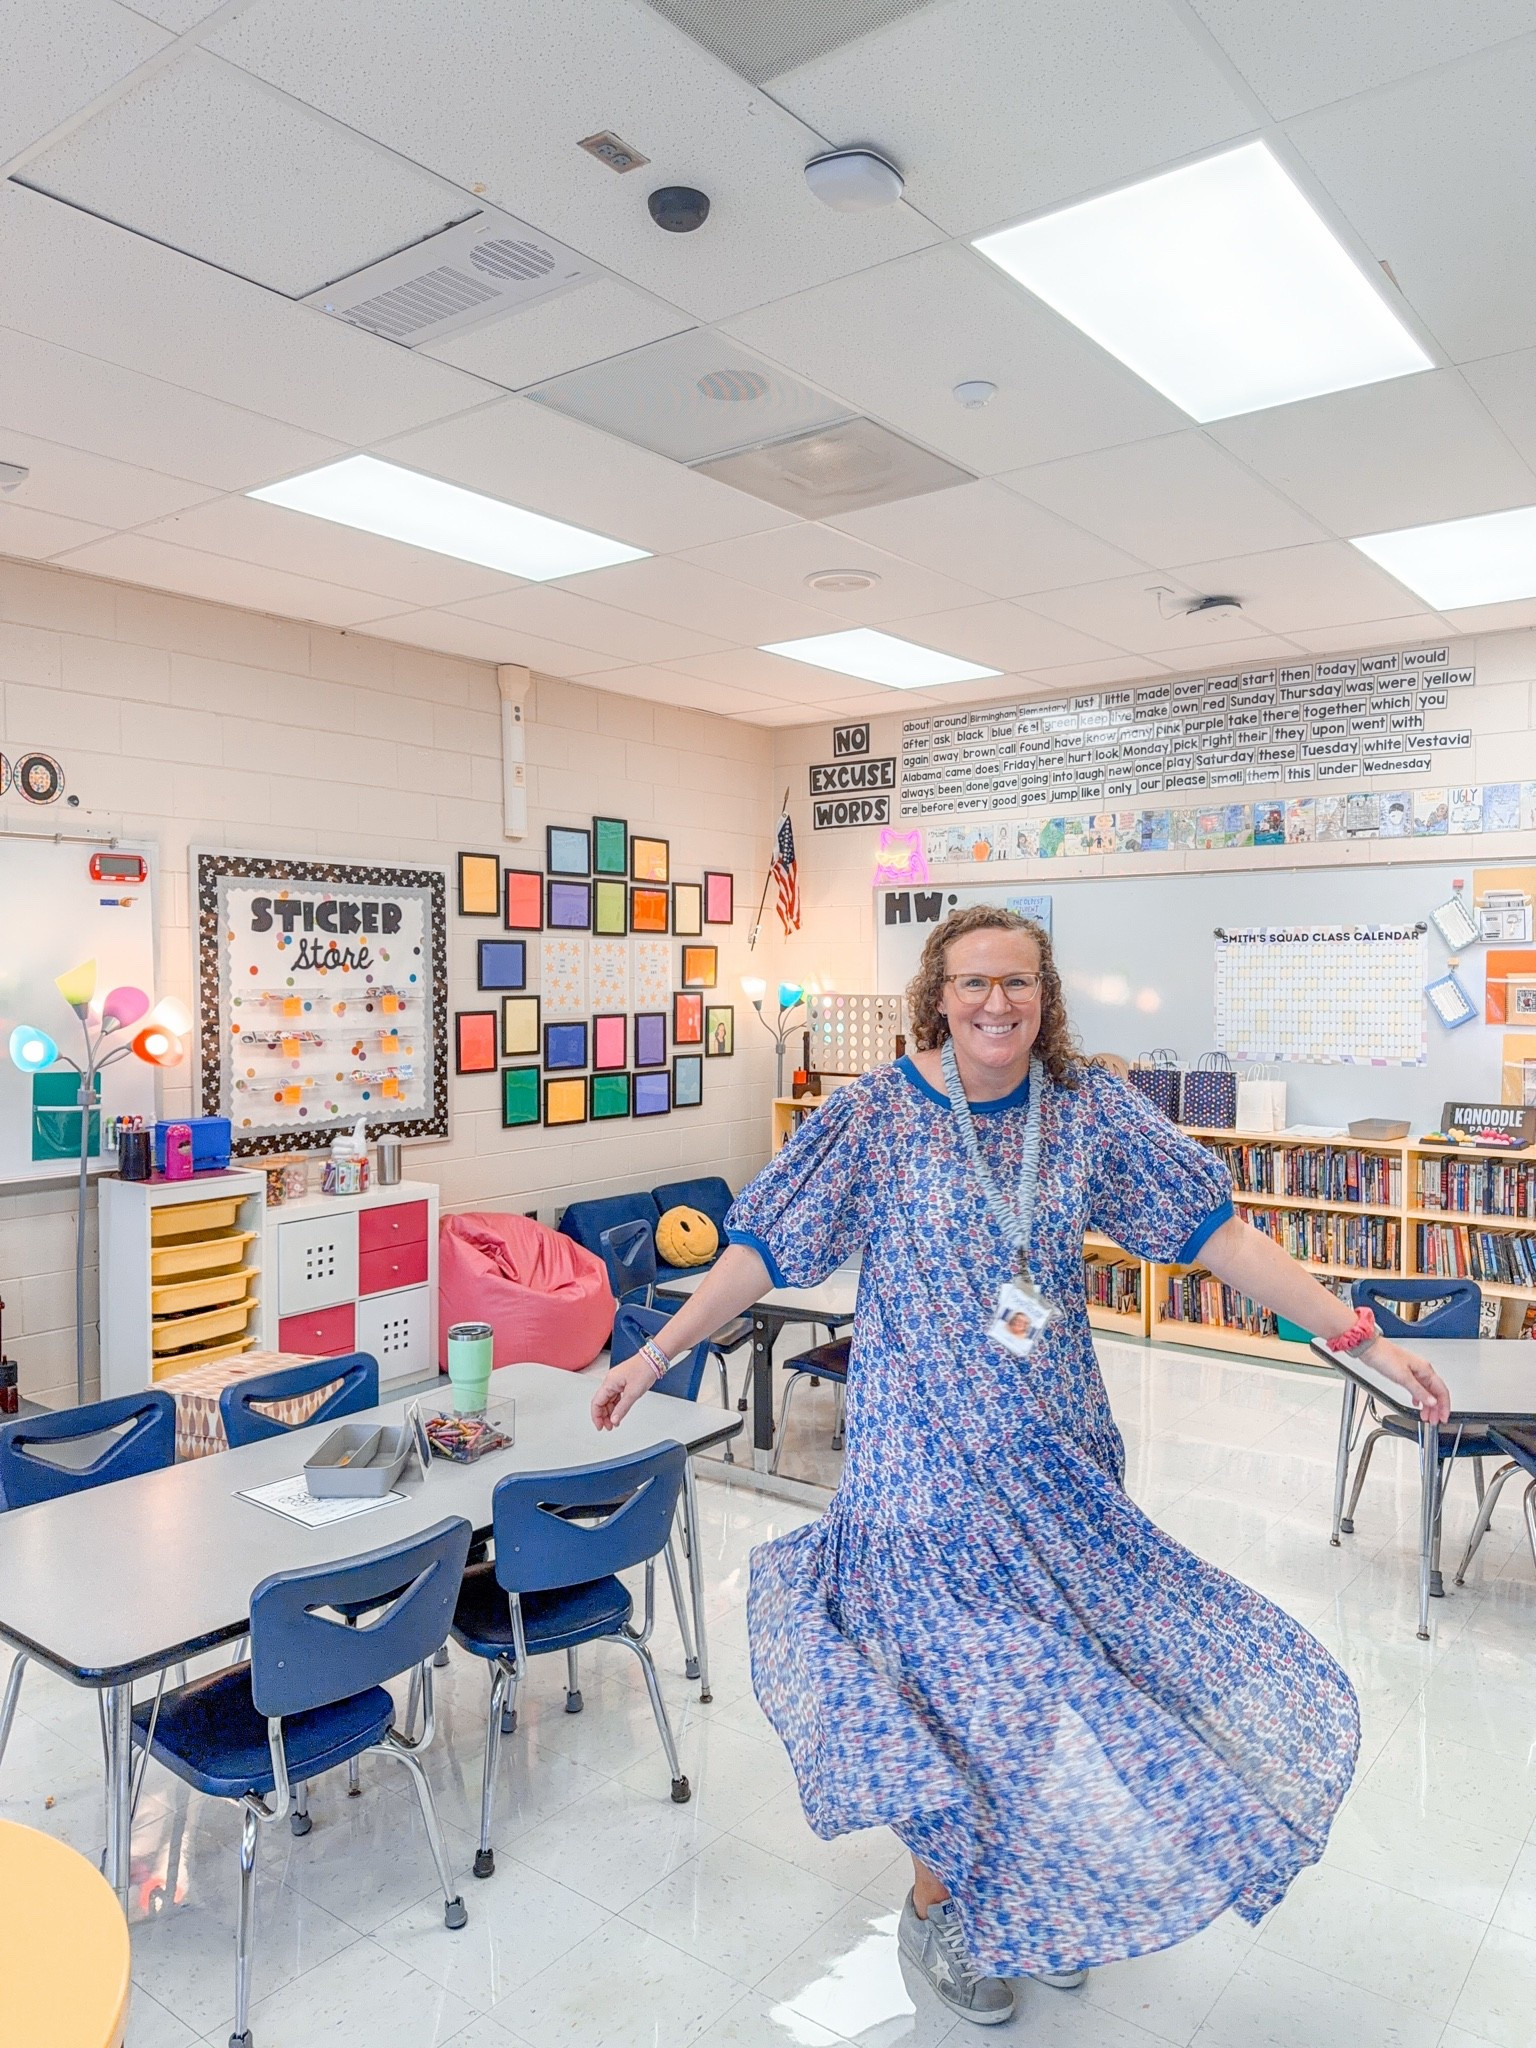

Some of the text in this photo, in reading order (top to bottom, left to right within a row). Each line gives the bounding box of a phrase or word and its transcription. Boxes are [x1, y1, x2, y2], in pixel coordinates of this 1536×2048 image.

[904, 650, 1446, 732] about around Birmingham Elementary just little made over read start then today want would
[904, 672, 1472, 749] after ask black blue feel green keep live make own red Sunday Thursday was were yellow
[836, 728, 865, 752] NO
[903, 715, 1422, 782] Alabama came does Friday here hurt look Monday pick right their they upon went with
[904, 695, 1445, 767] again away brown call found have know many pink purple take there together which you
[812, 762, 891, 791] EXCUSE
[902, 734, 1469, 799] always been done gave going into laugh new once play Saturday these Tuesday white Vestavia
[902, 758, 1431, 815] are before every good goes jump like only our please small them this under Wednesday
[1452, 788, 1478, 804] UGLY
[816, 799, 887, 825] WORDS
[251, 897, 402, 934] STICKER
[1222, 931, 1419, 943] SMITH'S SQUAD CLASS CALENDAR
[1454, 1107, 1523, 1127] KANOODLE
